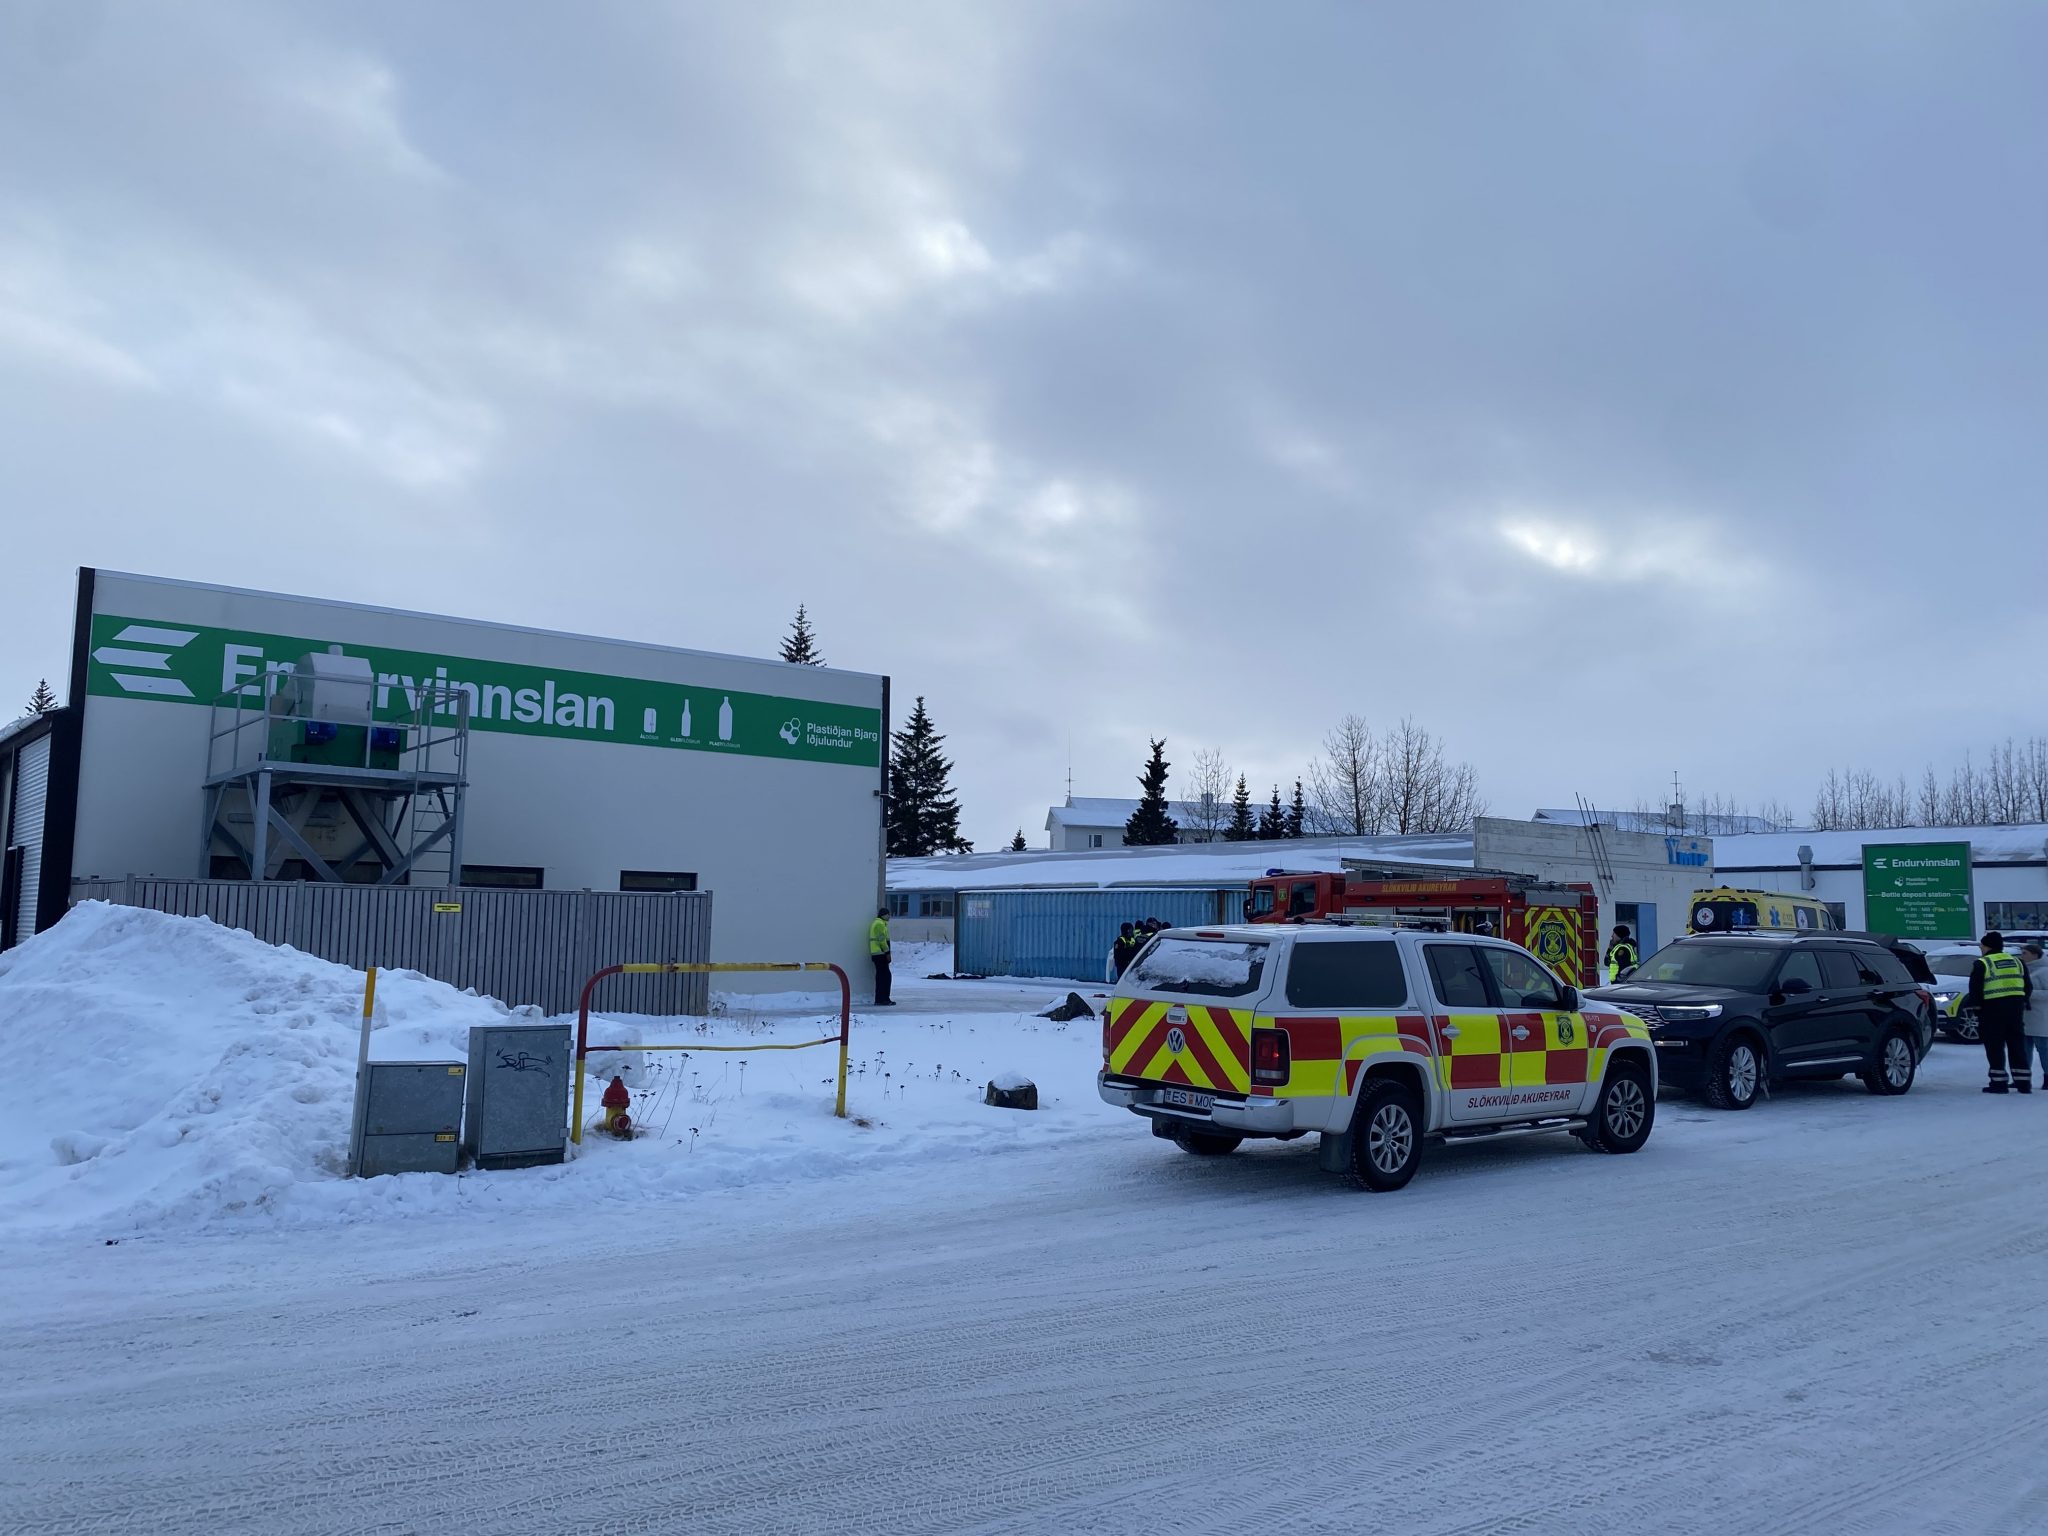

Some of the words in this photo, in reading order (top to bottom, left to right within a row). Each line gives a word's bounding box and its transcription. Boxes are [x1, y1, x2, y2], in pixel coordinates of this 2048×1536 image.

[222, 643, 615, 730] Enrvinnslan
[807, 723, 852, 738] Plastiðjan
[854, 728, 878, 742] Bjarg
[807, 735, 853, 748] Iðjulundur
[1892, 858, 1960, 868] Endurvinnslan
[1172, 1091, 1187, 1104] ES
[1467, 1094, 1520, 1108] SLÖKKVILIÐ
[1520, 1089, 1571, 1104] AKUREYRAR
